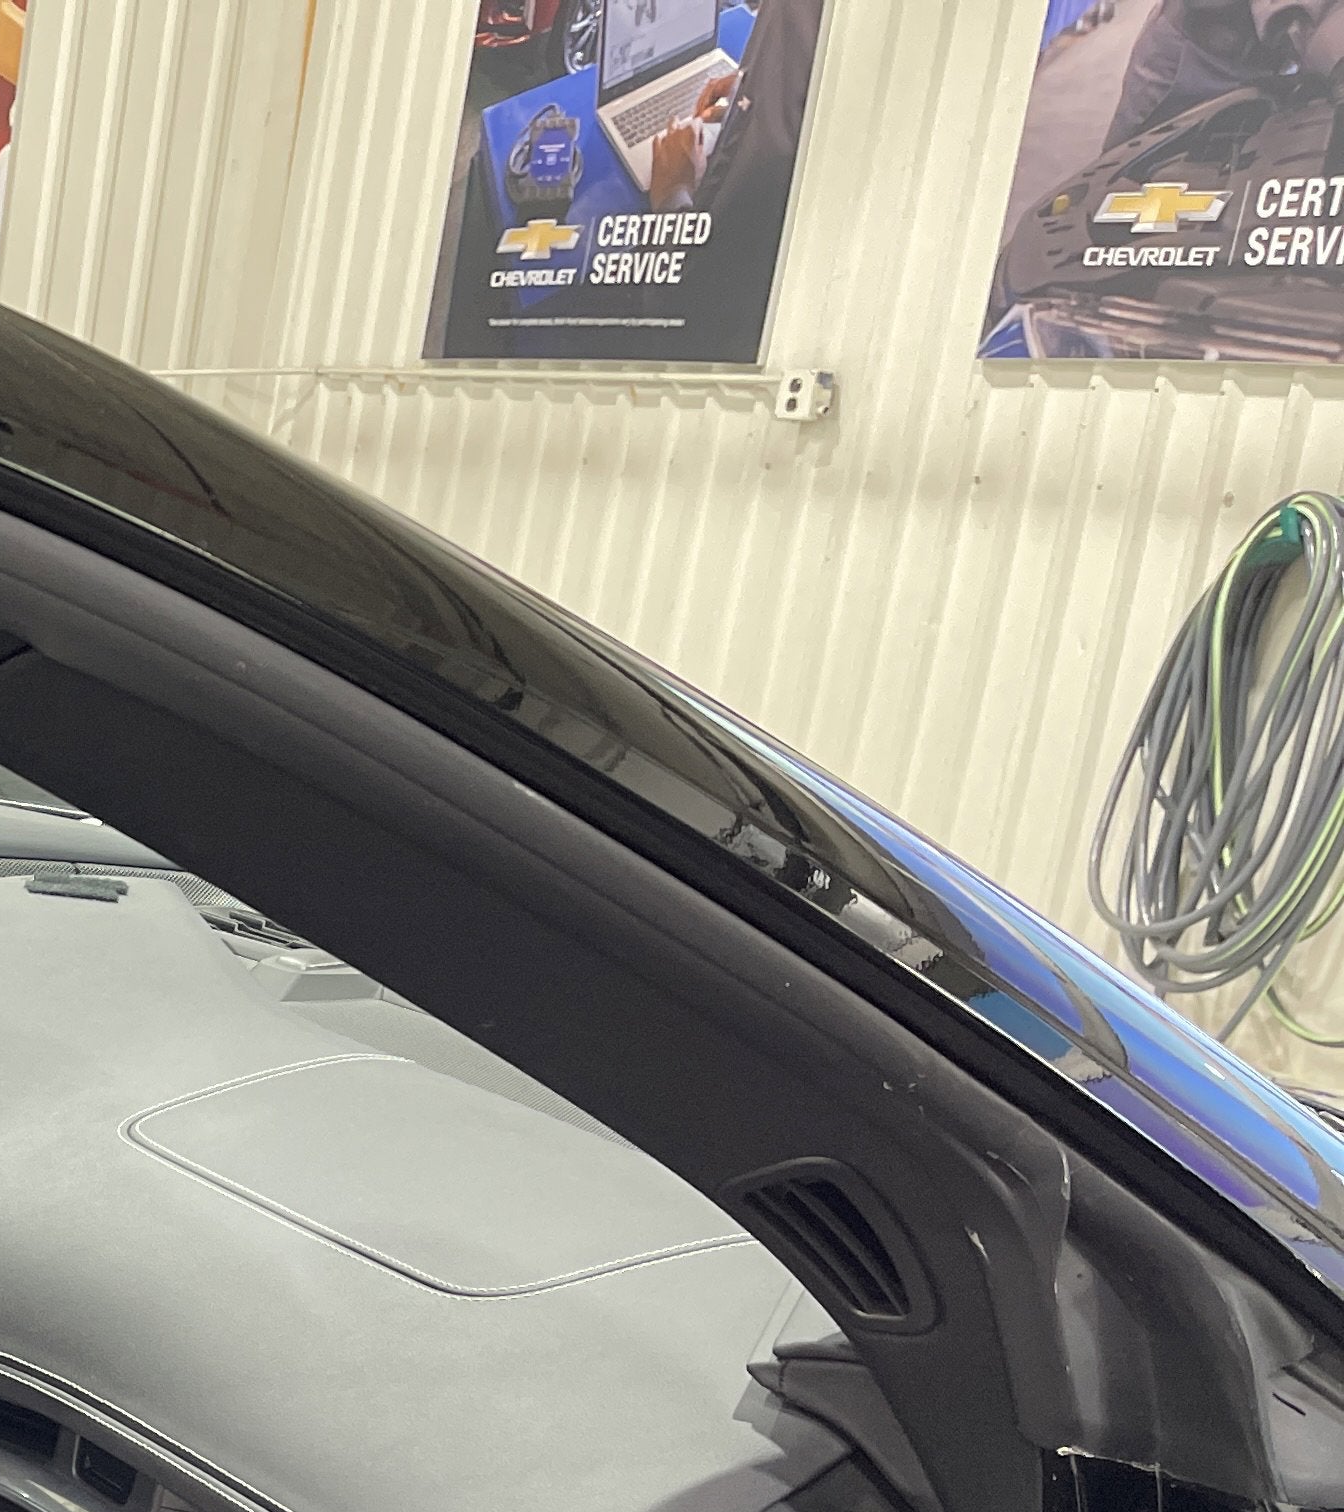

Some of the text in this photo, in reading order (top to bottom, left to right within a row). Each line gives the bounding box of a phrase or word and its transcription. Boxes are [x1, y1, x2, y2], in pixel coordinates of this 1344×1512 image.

[597, 212, 712, 247] CERTIFIED
[589, 252, 686, 284] SERVICE
[1082, 246, 1221, 267] CHEVROLET
[490, 268, 578, 288] CHEVROLET
